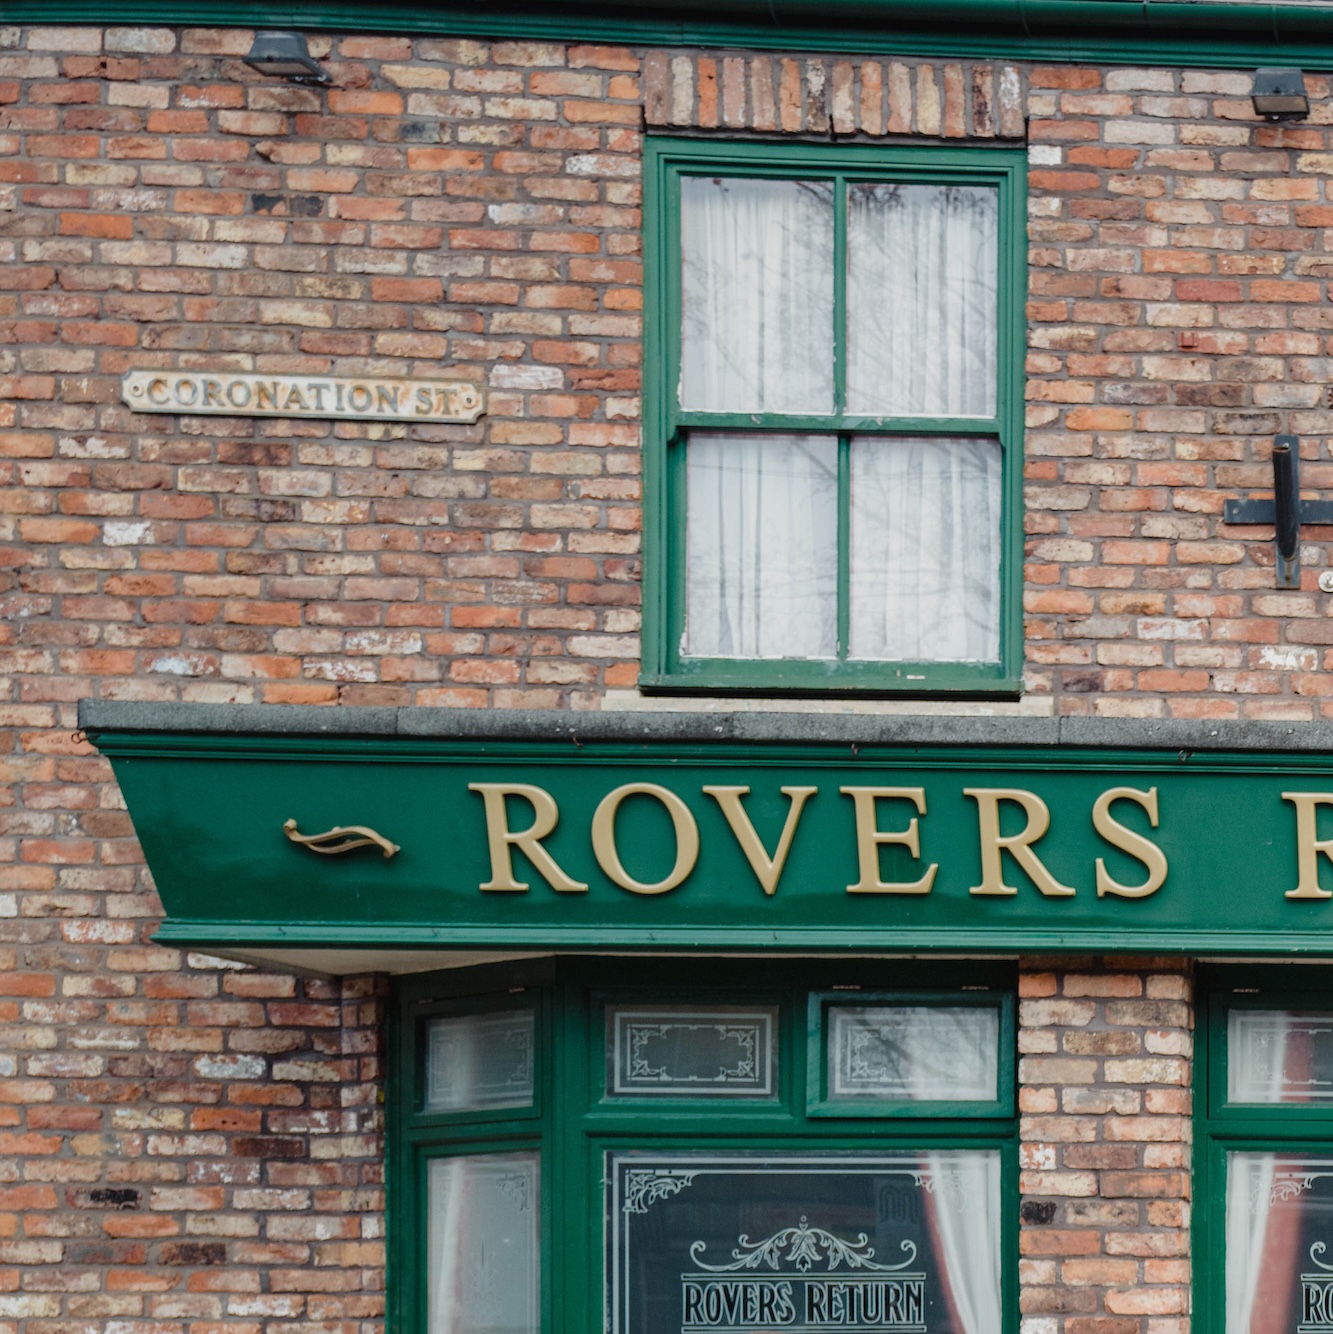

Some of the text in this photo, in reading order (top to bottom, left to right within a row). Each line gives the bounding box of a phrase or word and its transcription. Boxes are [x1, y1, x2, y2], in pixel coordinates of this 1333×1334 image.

[147, 378, 460, 416] CORONATION ST.
[468, 782, 1168, 899] ROVERS
[682, 1280, 925, 1325] ROVERS RETURN
